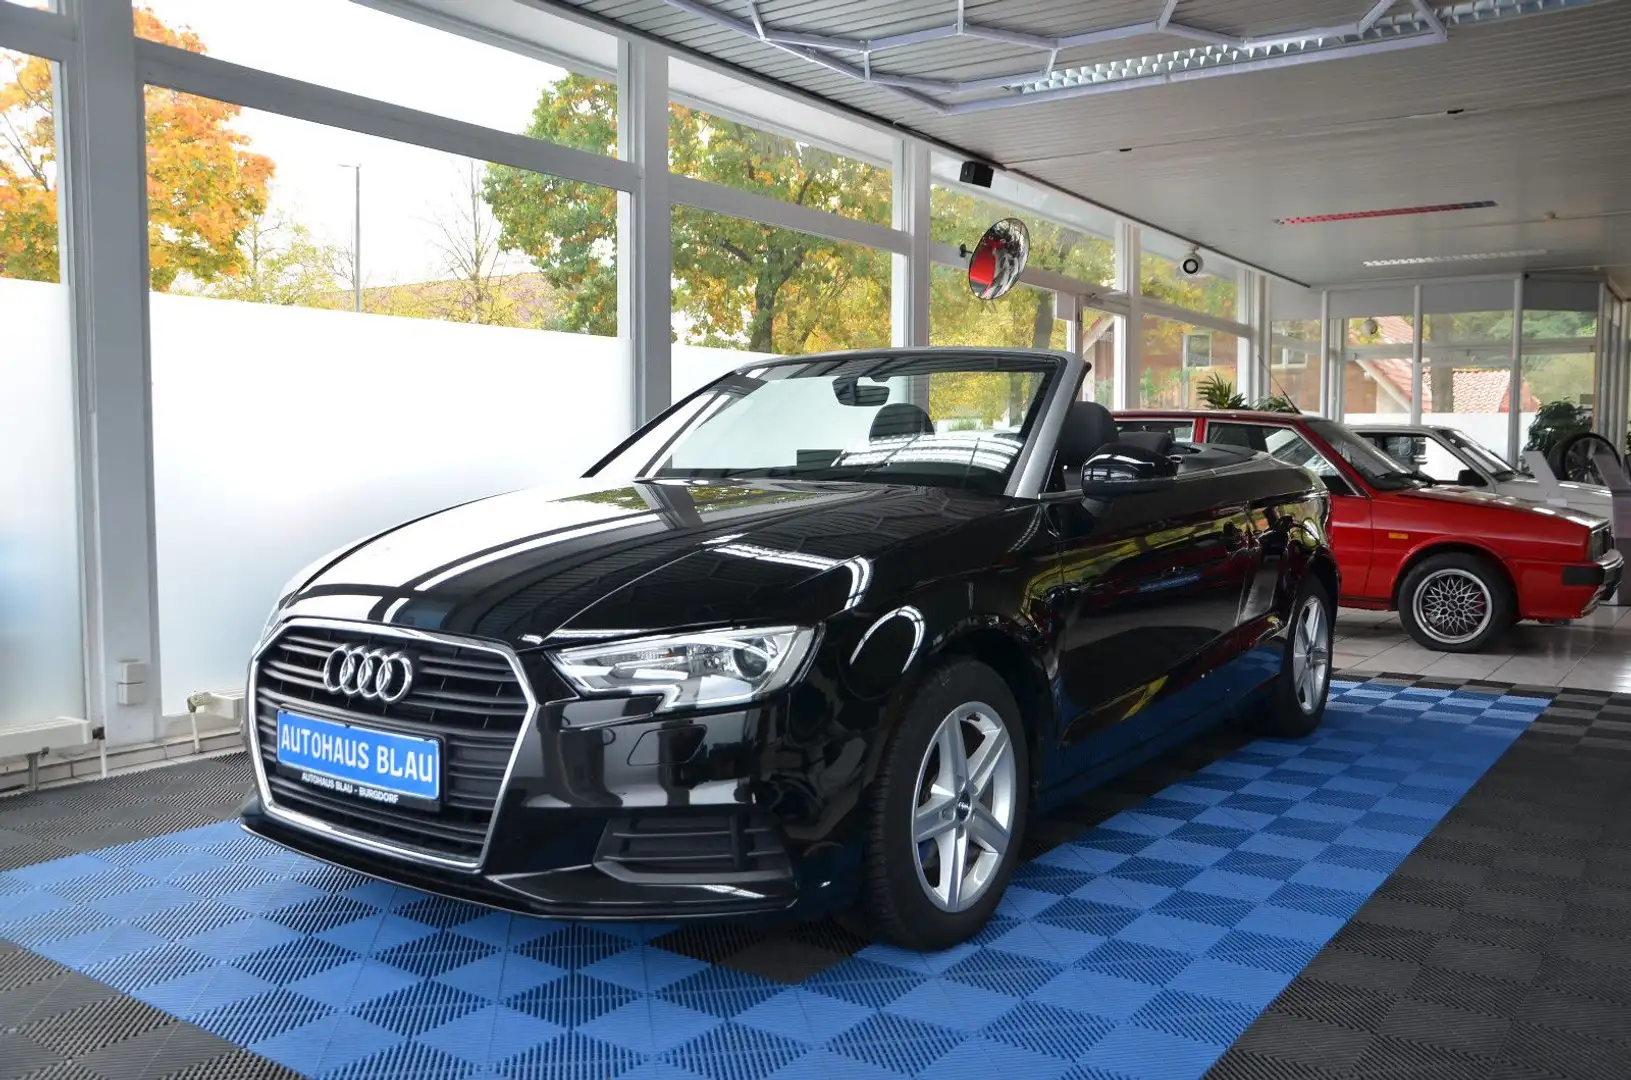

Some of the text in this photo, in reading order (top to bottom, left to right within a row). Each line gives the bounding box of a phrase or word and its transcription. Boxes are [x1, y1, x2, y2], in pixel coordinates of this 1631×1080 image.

[281, 724, 433, 783] AUTOHAUS BLAU
[302, 772, 334, 788] AUTOHAUS
[336, 781, 352, 794] BLAU
[359, 786, 399, 804] BURGDORF
